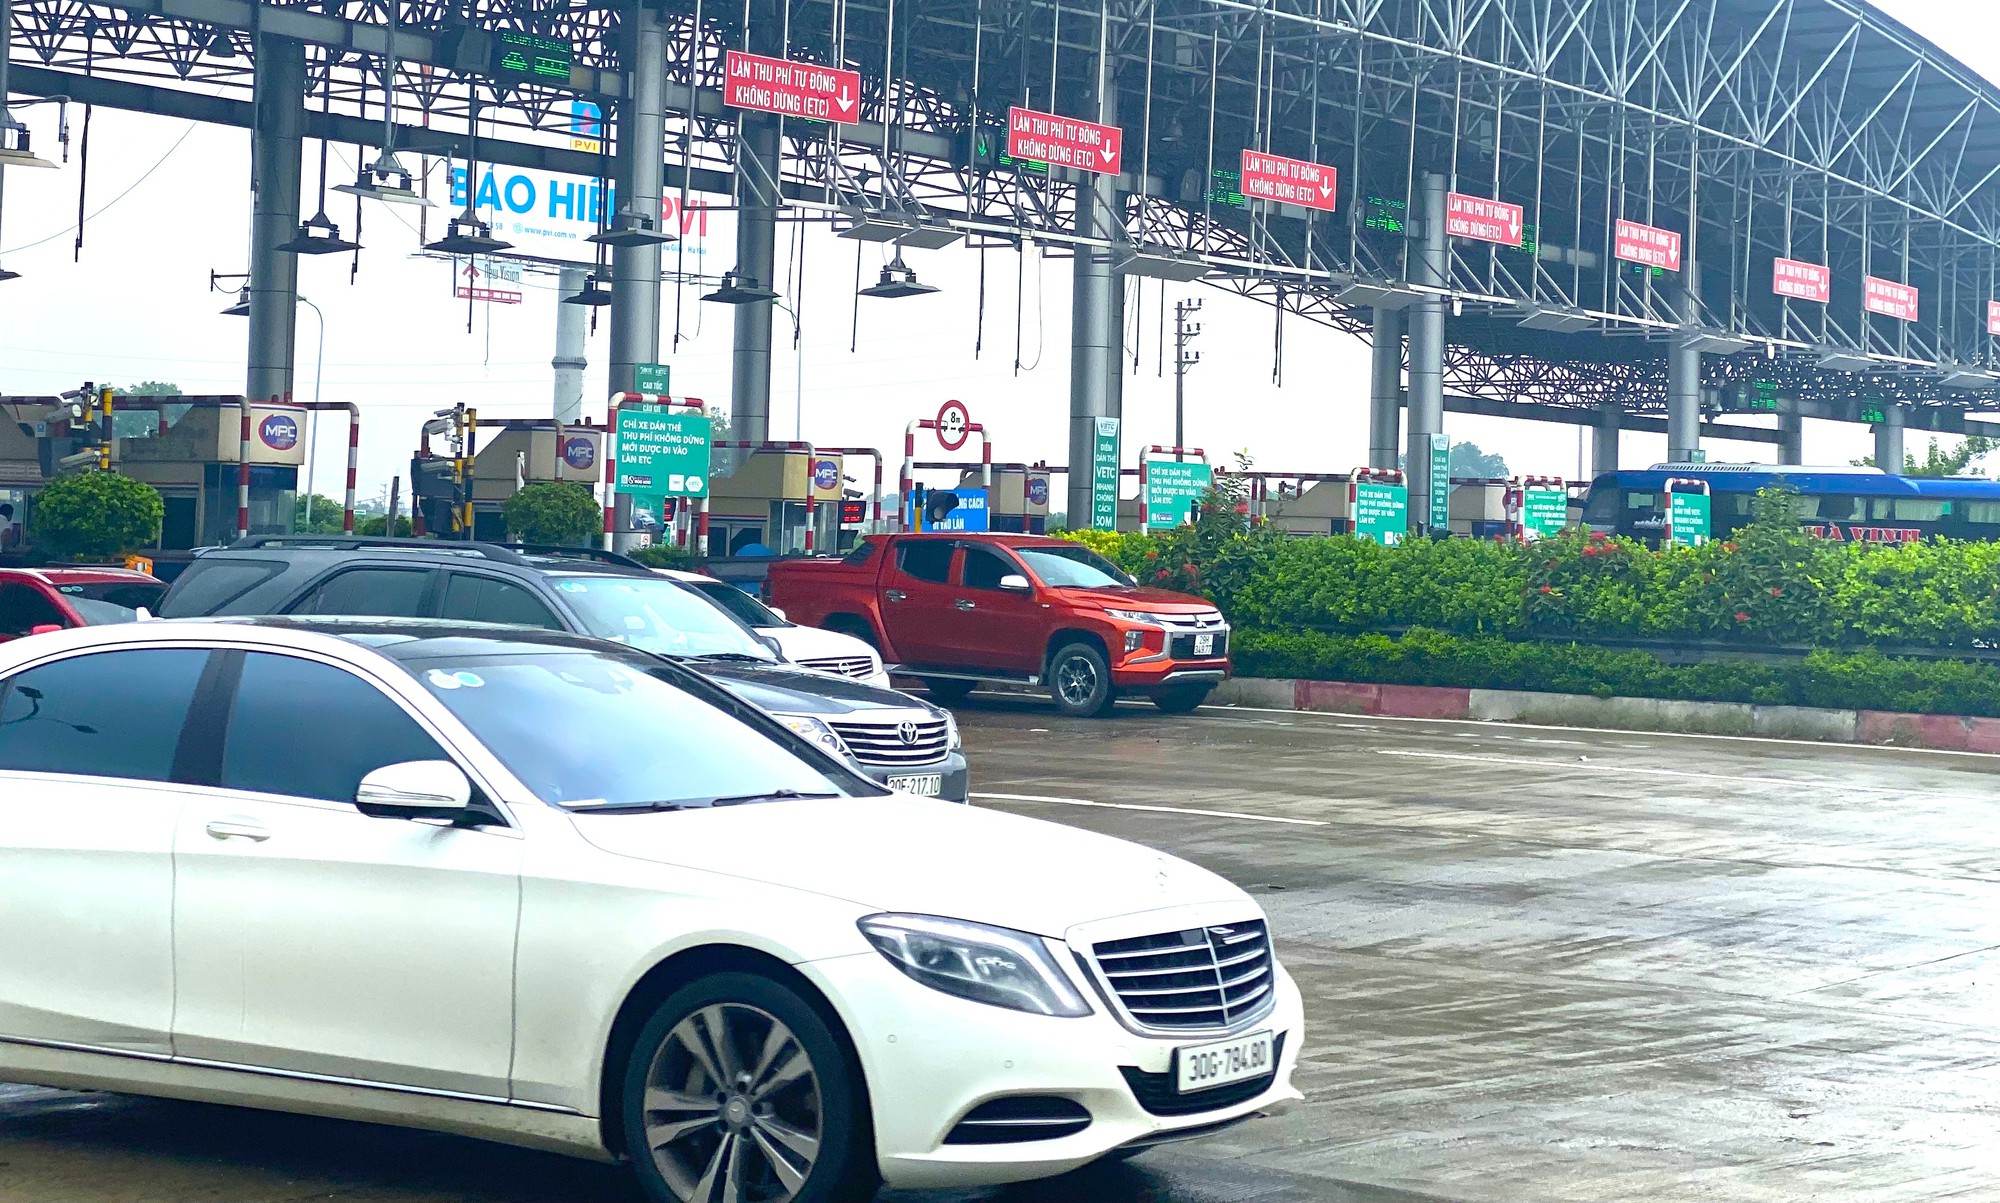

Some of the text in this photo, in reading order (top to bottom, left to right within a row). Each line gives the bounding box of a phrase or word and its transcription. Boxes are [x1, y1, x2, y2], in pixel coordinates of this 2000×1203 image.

[731, 56, 836, 93] LÀN THU PHÍ TỰ ĐỘNG
[736, 85, 829, 116] KHÔNG DỪNG (ETC)
[1014, 112, 1029, 132] LÀN
[1032, 118, 1048, 135] THU
[1051, 120, 1065, 138] PHÍ
[1066, 125, 1077, 144] TỰ
[1079, 126, 1100, 147] ĐỘNG
[574, 140, 596, 151] PVI
[1018, 138, 1094, 167] KHÔNG DỪNG (ETC)
[1246, 154, 1319, 183] LÀN THU PHÍ TỰ ĐỘNG
[1250, 177, 1273, 195] KHÔNG
[1276, 180, 1294, 199] DỪNG
[1297, 186, 1314, 202] (ETC)
[1450, 196, 1509, 222] LÀN THU PHÍ TỰ ĐỘNG
[524, 226, 577, 240] www.pvi.com.vn
[1450, 217, 1468, 233] KHÔNG
[1470, 219, 1486, 236] DỪNG
[1486, 222, 1502, 239] (ETC)
[643, 382, 652, 390] CAO
[266, 425, 295, 437] MPC
[623, 418, 636, 429] CHỈ
[650, 420, 666, 430] DÁN
[668, 422, 681, 432] THẺ
[622, 431, 704, 445] THU PHÍ KHÔNG DỪNG
[568, 447, 592, 458] MPC
[622, 442, 688, 456] MỚI ĐƯỢC ĐI VÀO
[622, 453, 652, 464] LÀN ETC
[1096, 454, 1116, 463] DÁN THẺ
[816, 469, 837, 479] MPC
[1096, 466, 1115, 478] VETC
[1096, 483, 1114, 491] NHANH
[969, 494, 984, 509] CÁCH
[1096, 494, 1114, 502] CHÓNG
[1098, 504, 1111, 512] CÁCH
[953, 516, 964, 530] LÀN
[1096, 516, 1112, 527] 50M
[1849, 527, 1921, 543] VINH
